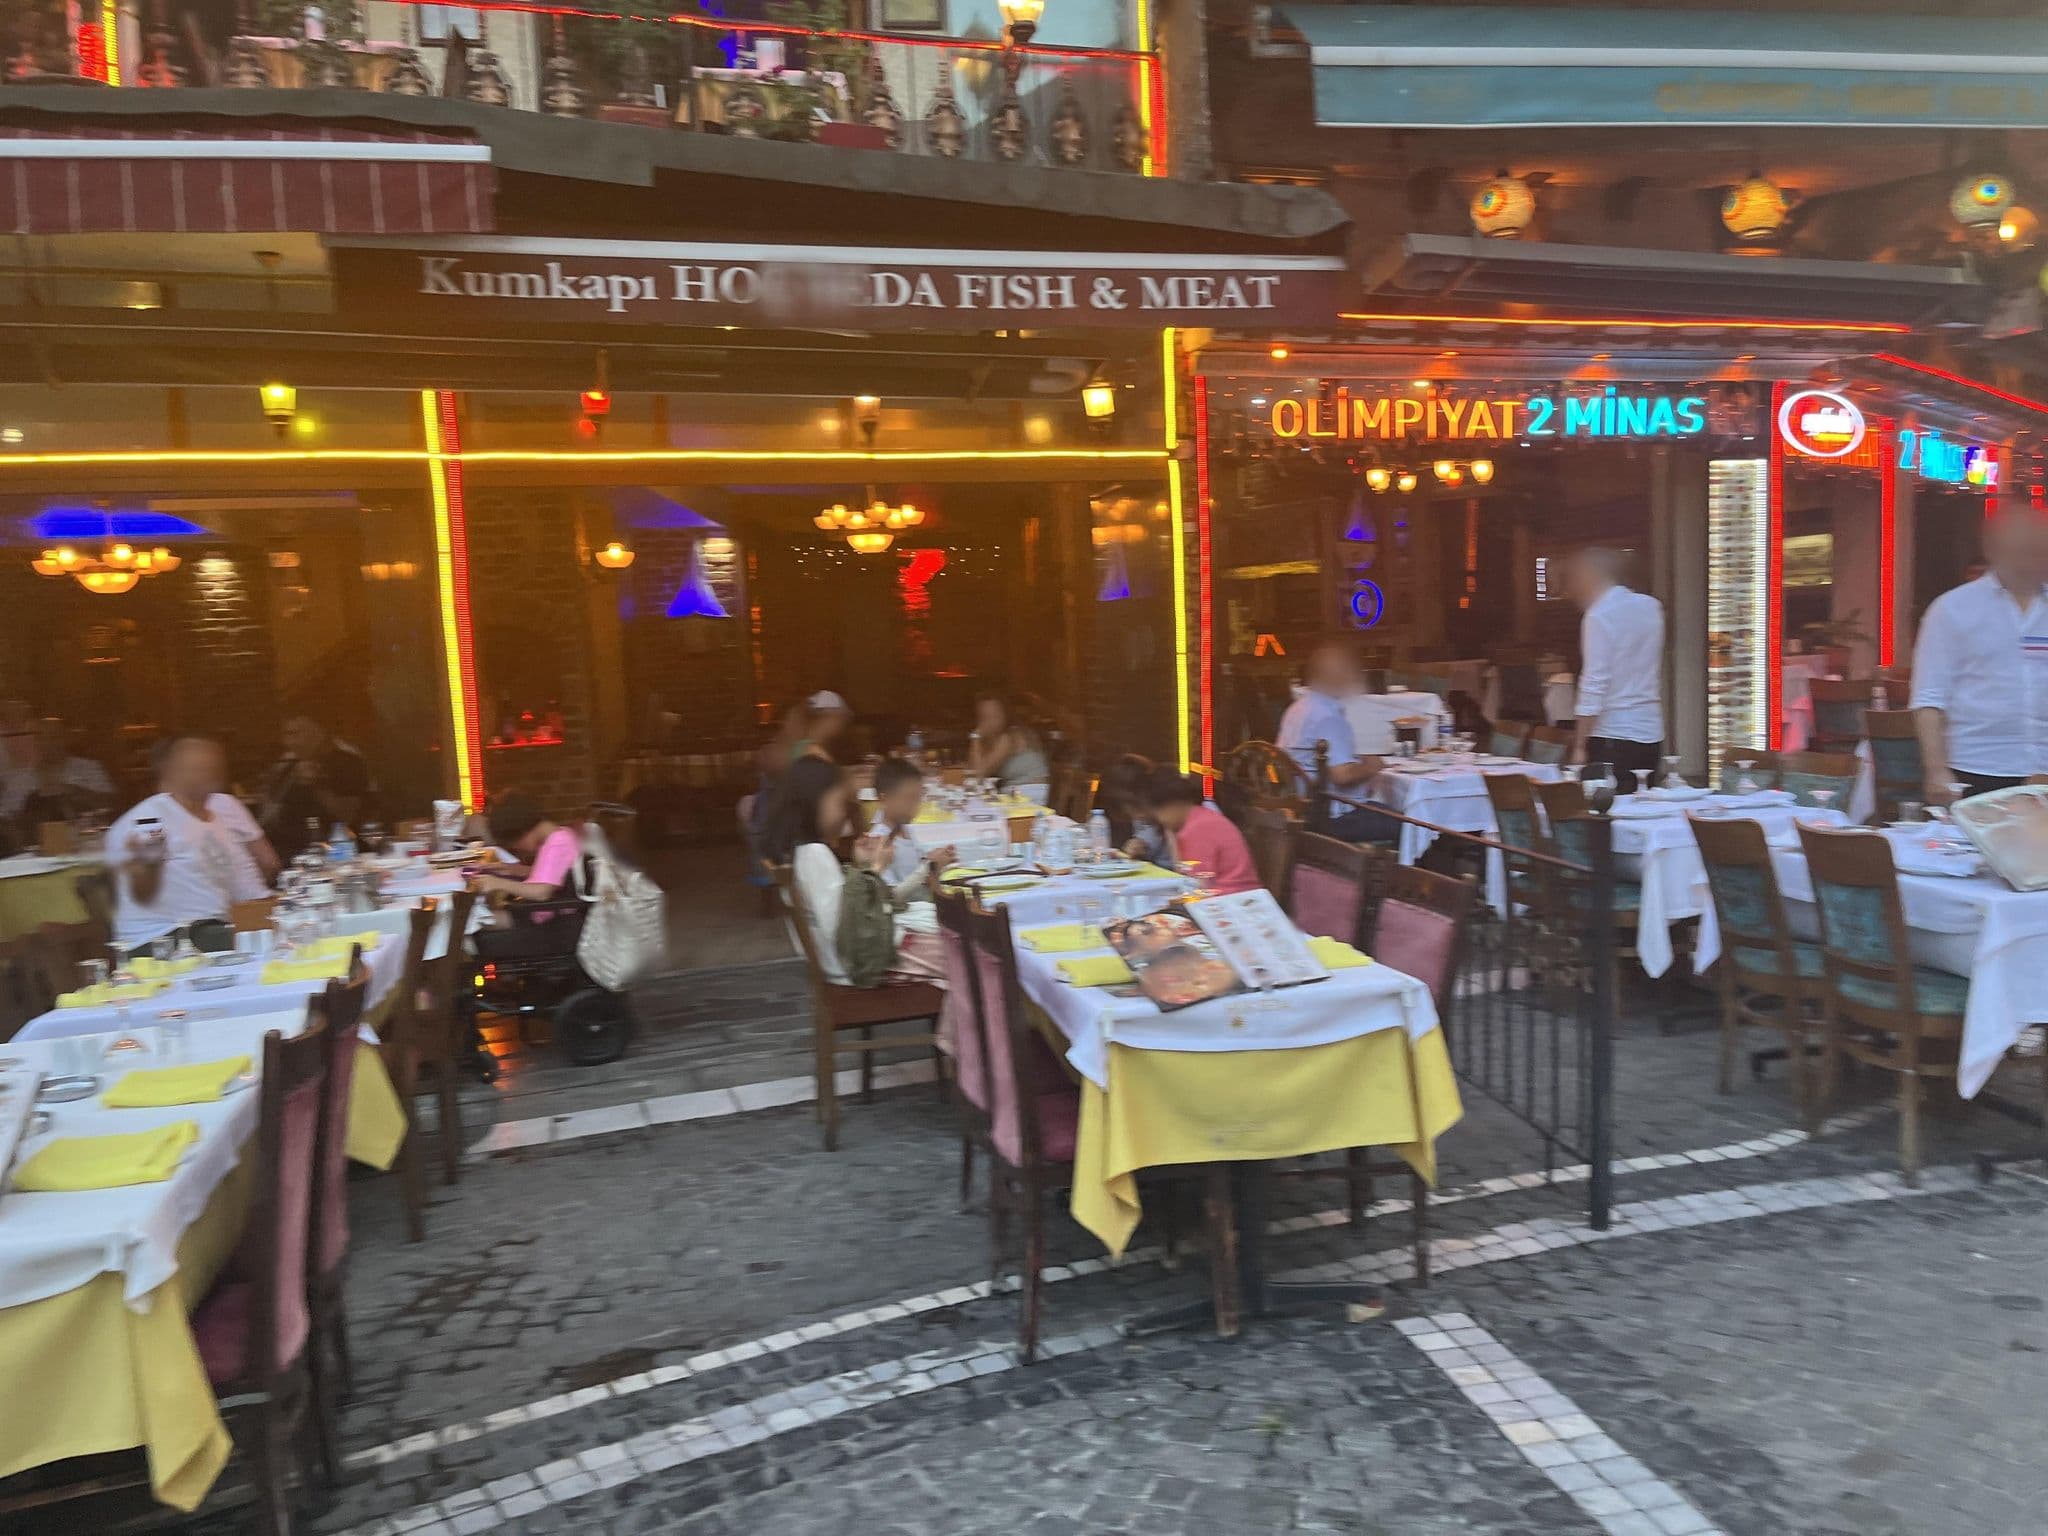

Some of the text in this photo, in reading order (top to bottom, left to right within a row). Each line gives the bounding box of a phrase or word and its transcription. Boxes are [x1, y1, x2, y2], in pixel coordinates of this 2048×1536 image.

[418, 256, 1281, 312] Kumkapı HODA FISH & MEAT
[1271, 386, 1705, 439] OLİMPİYAT 2 MİNAS
